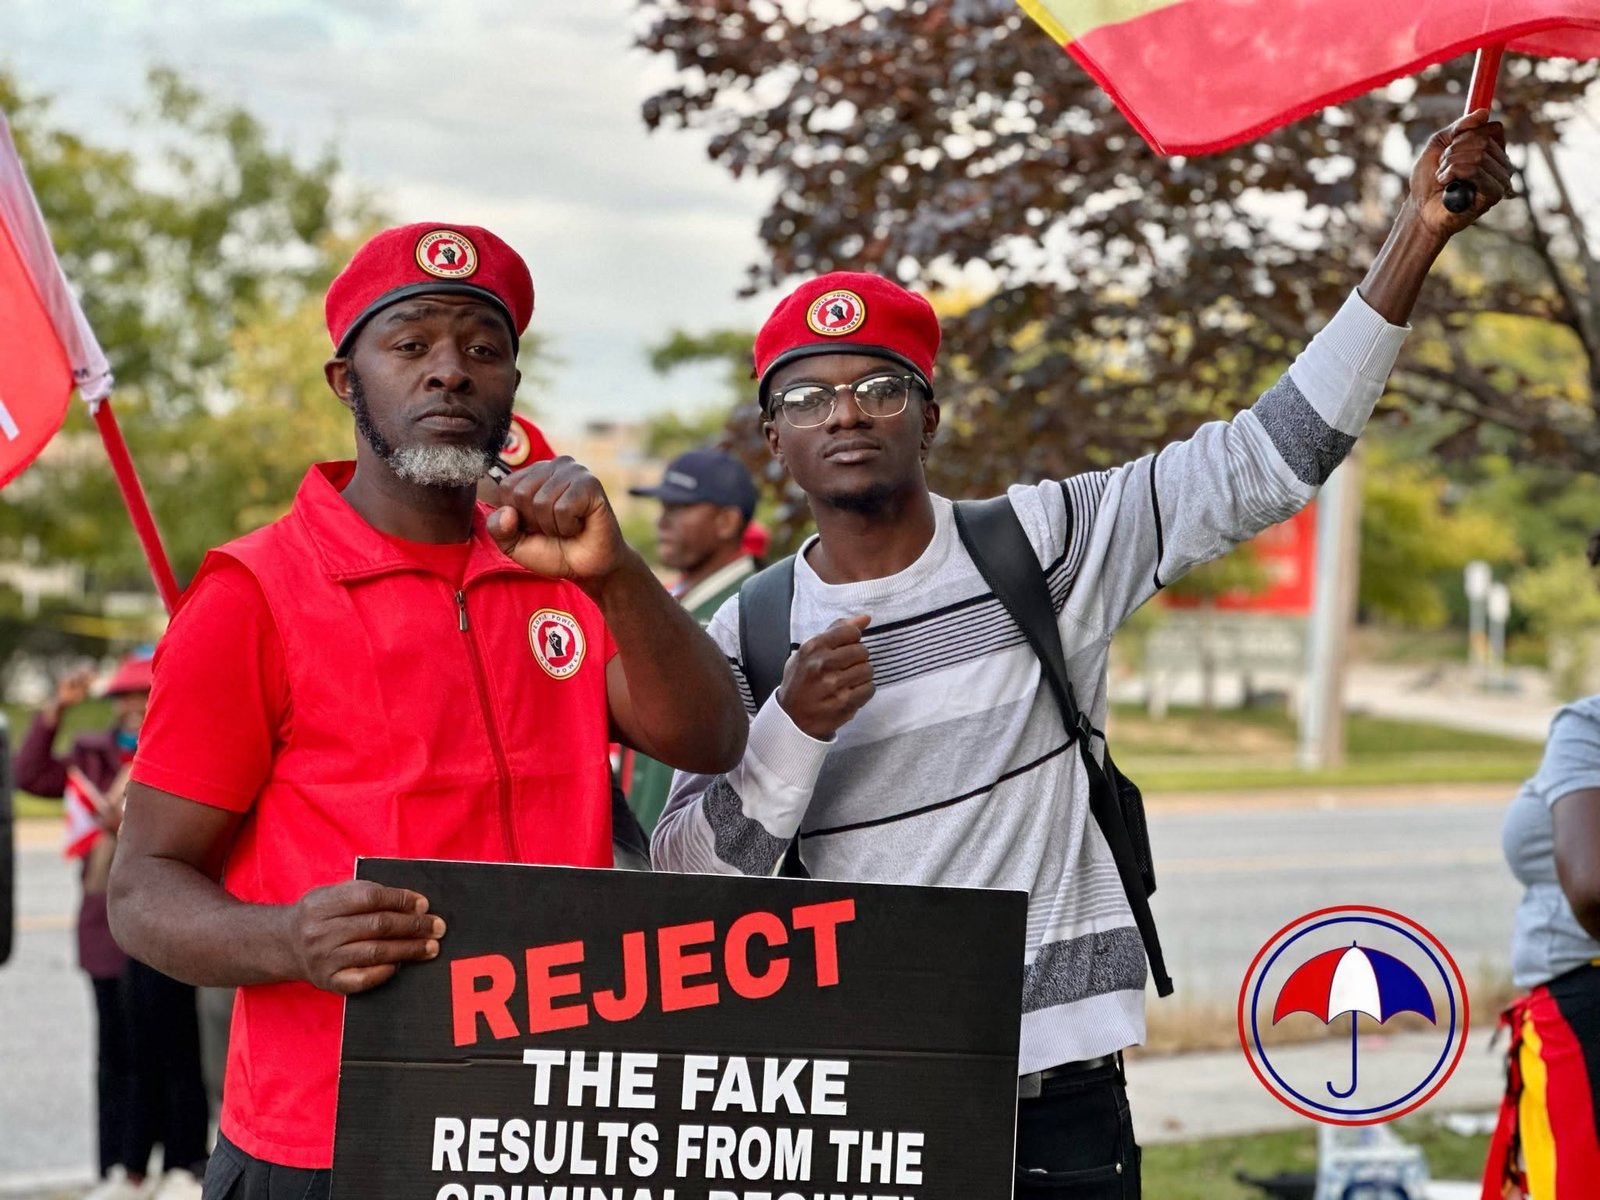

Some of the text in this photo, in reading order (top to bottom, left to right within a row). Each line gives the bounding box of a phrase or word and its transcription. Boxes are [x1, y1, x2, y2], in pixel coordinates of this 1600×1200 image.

[551, 615, 575, 629] POWER
[556, 651, 580, 674] POWER
[450, 899, 855, 1047] REJECT
[522, 1048, 850, 1116] THE FAKE
[431, 1117, 925, 1185] RESULTS FROM THE
